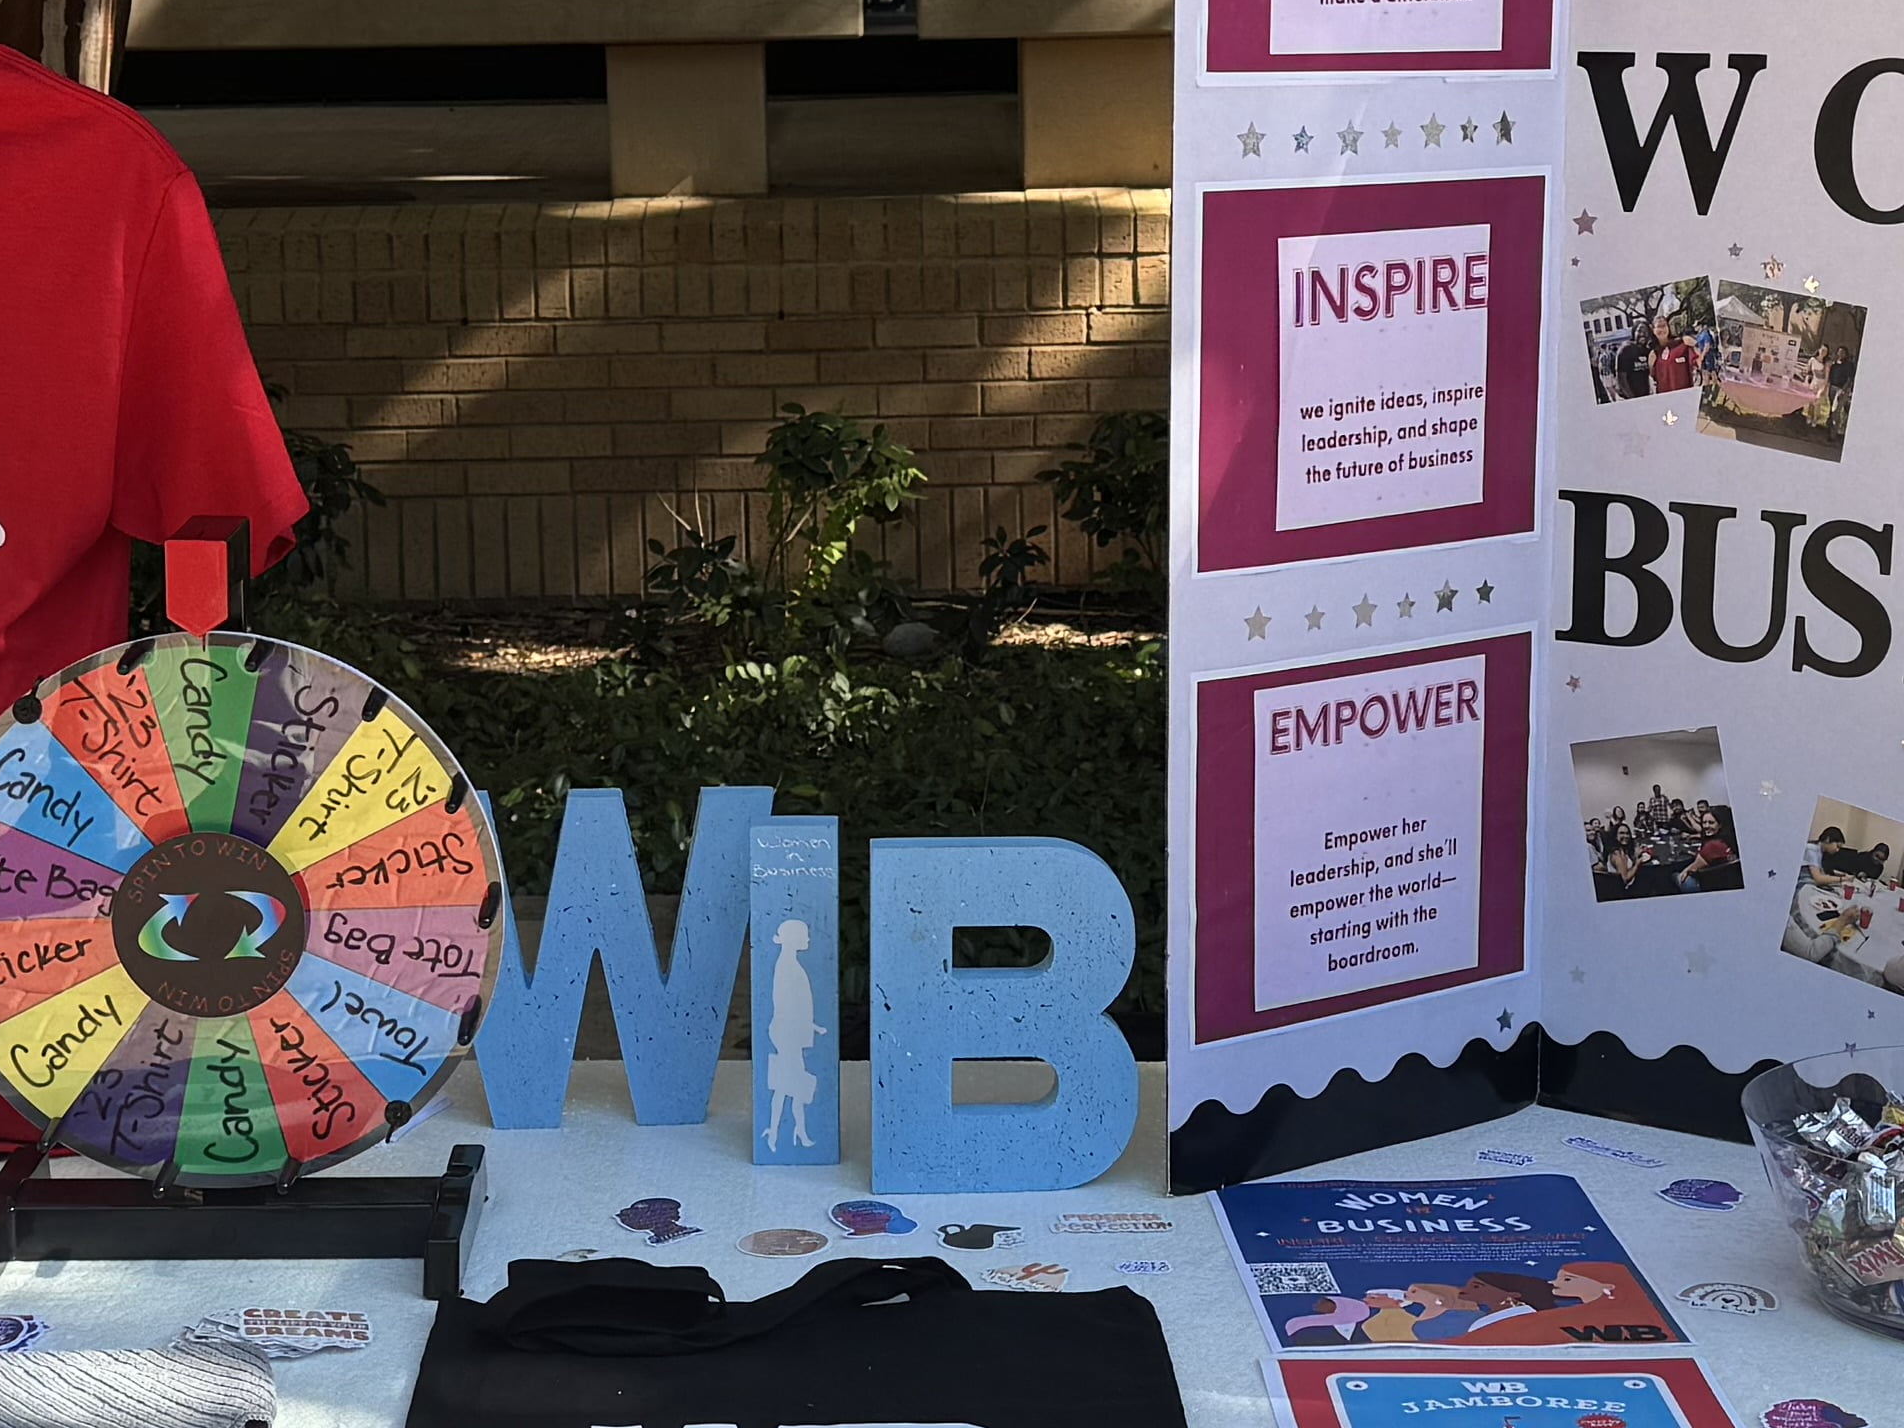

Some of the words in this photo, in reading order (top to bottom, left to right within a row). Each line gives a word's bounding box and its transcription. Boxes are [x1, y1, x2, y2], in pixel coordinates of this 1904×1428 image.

[1293, 251, 1488, 327] INSPIRE
[1300, 404, 1324, 420] we
[1329, 395, 1376, 421] ignite
[1381, 391, 1427, 414] ideas,
[1432, 384, 1484, 408] inspire
[1302, 427, 1393, 453] leadership,
[1397, 419, 1427, 440] and
[1431, 416, 1478, 441] shape
[1306, 465, 1331, 484] the
[1336, 458, 1383, 480] future
[1388, 453, 1405, 473] of
[1408, 447, 1473, 470] business
[179, 657, 227, 786] Candy
[1269, 679, 1481, 756] EMPOWER
[61, 677, 164, 818] T-Shirt
[249, 682, 341, 827] Sticker
[299, 727, 419, 842] T-Shirt
[757, 835, 831, 849] Women
[1324, 822, 1398, 851] Empower
[1402, 816, 1427, 835] her
[128, 853, 172, 904] SPIN
[173, 839, 207, 859] TO
[216, 839, 269, 872] WIN
[325, 833, 473, 889] Sticker
[753, 863, 833, 879] Business
[1290, 857, 1379, 888] leadership,
[1384, 847, 1414, 869] and
[44, 865, 116, 917] Bag
[1289, 892, 1365, 920] empower
[1368, 884, 1394, 904] the
[324, 911, 394, 966] Bag
[1309, 918, 1371, 947] starting
[1375, 909, 1409, 932] with
[1413, 903, 1438, 923] the
[252, 949, 295, 999] SPIN
[403, 936, 481, 981] Tote
[1327, 942, 1420, 972] boardroom.
[157, 981, 209, 1012] WIN
[218, 992, 253, 1012] TO
[471, 786, 1140, 1194] WIB
[9, 994, 127, 1089] Candy
[320, 981, 429, 1077] Towel
[111, 1018, 183, 1155] T-Shirt
[270, 1017, 356, 1141] Sticker
[203, 1039, 260, 1164] Candy
[1335, 1191, 1488, 1211] WOMEN
[1054, 1221, 1173, 1233] PERFECTION
[1317, 1216, 1532, 1235] BUSINESS
[243, 1308, 368, 1322] CREATE
[244, 1326, 369, 1341] DREAMS
[330, 1322, 366, 1330] YOUR
[1401, 1395, 1627, 1414] JAMBOREE
